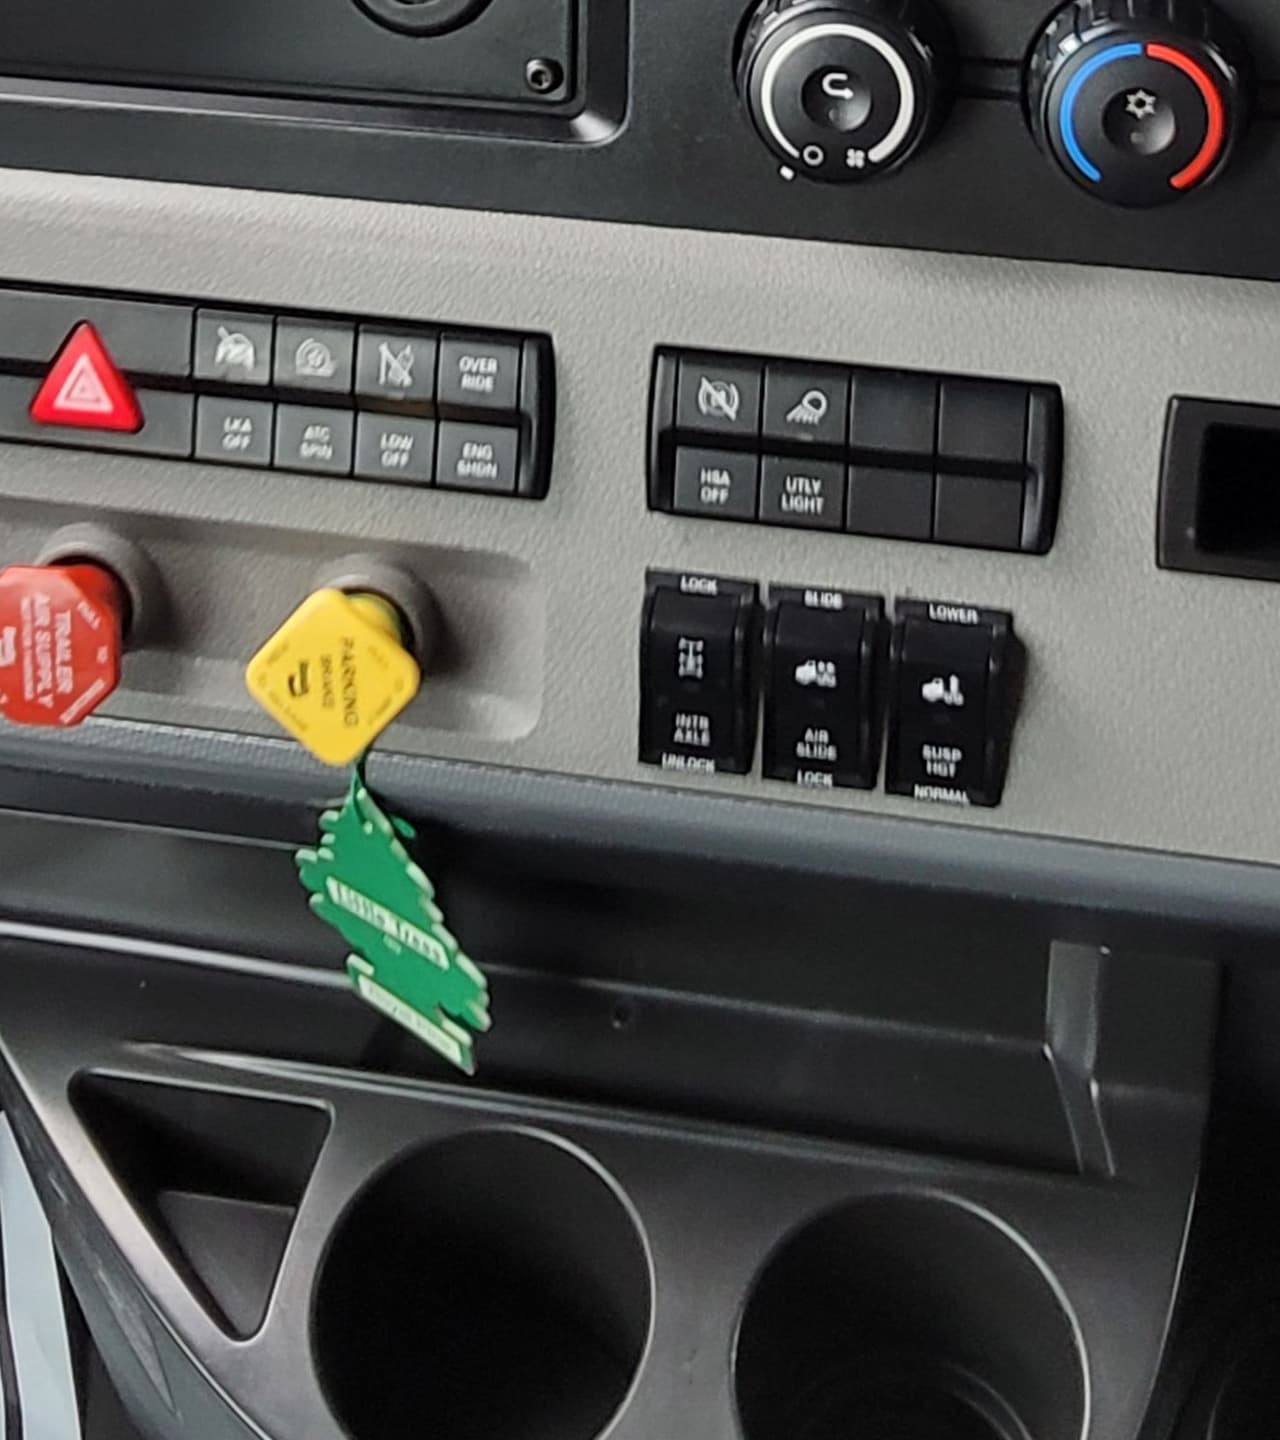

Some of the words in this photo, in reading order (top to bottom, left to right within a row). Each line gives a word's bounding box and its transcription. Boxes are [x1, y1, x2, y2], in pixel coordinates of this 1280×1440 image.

[459, 356, 499, 374] OVER
[461, 375, 494, 392] RIDE
[223, 416, 253, 433] LKA
[223, 433, 250, 450] OFF
[300, 442, 333, 460] SPIN
[381, 450, 411, 468] OFF
[463, 442, 494, 461] ENG
[700, 486, 729, 504] OFF
[786, 475, 821, 496] UTLY
[781, 493, 825, 516] LIGHT
[680, 575, 718, 596] LOCK
[33, 591, 51, 627] AIR
[929, 603, 979, 625] LOWER
[55, 609, 73, 695] TRAILER
[35, 629, 54, 708] SUPPLY
[321, 654, 335, 709] BRAKE
[340, 635, 359, 728] PARKING
[673, 728, 711, 747] AXLE
[662, 753, 715, 774] UNLOCK
[926, 761, 956, 779] HGT
[796, 769, 833, 788] LOCK
[914, 783, 970, 803] NORMAL
